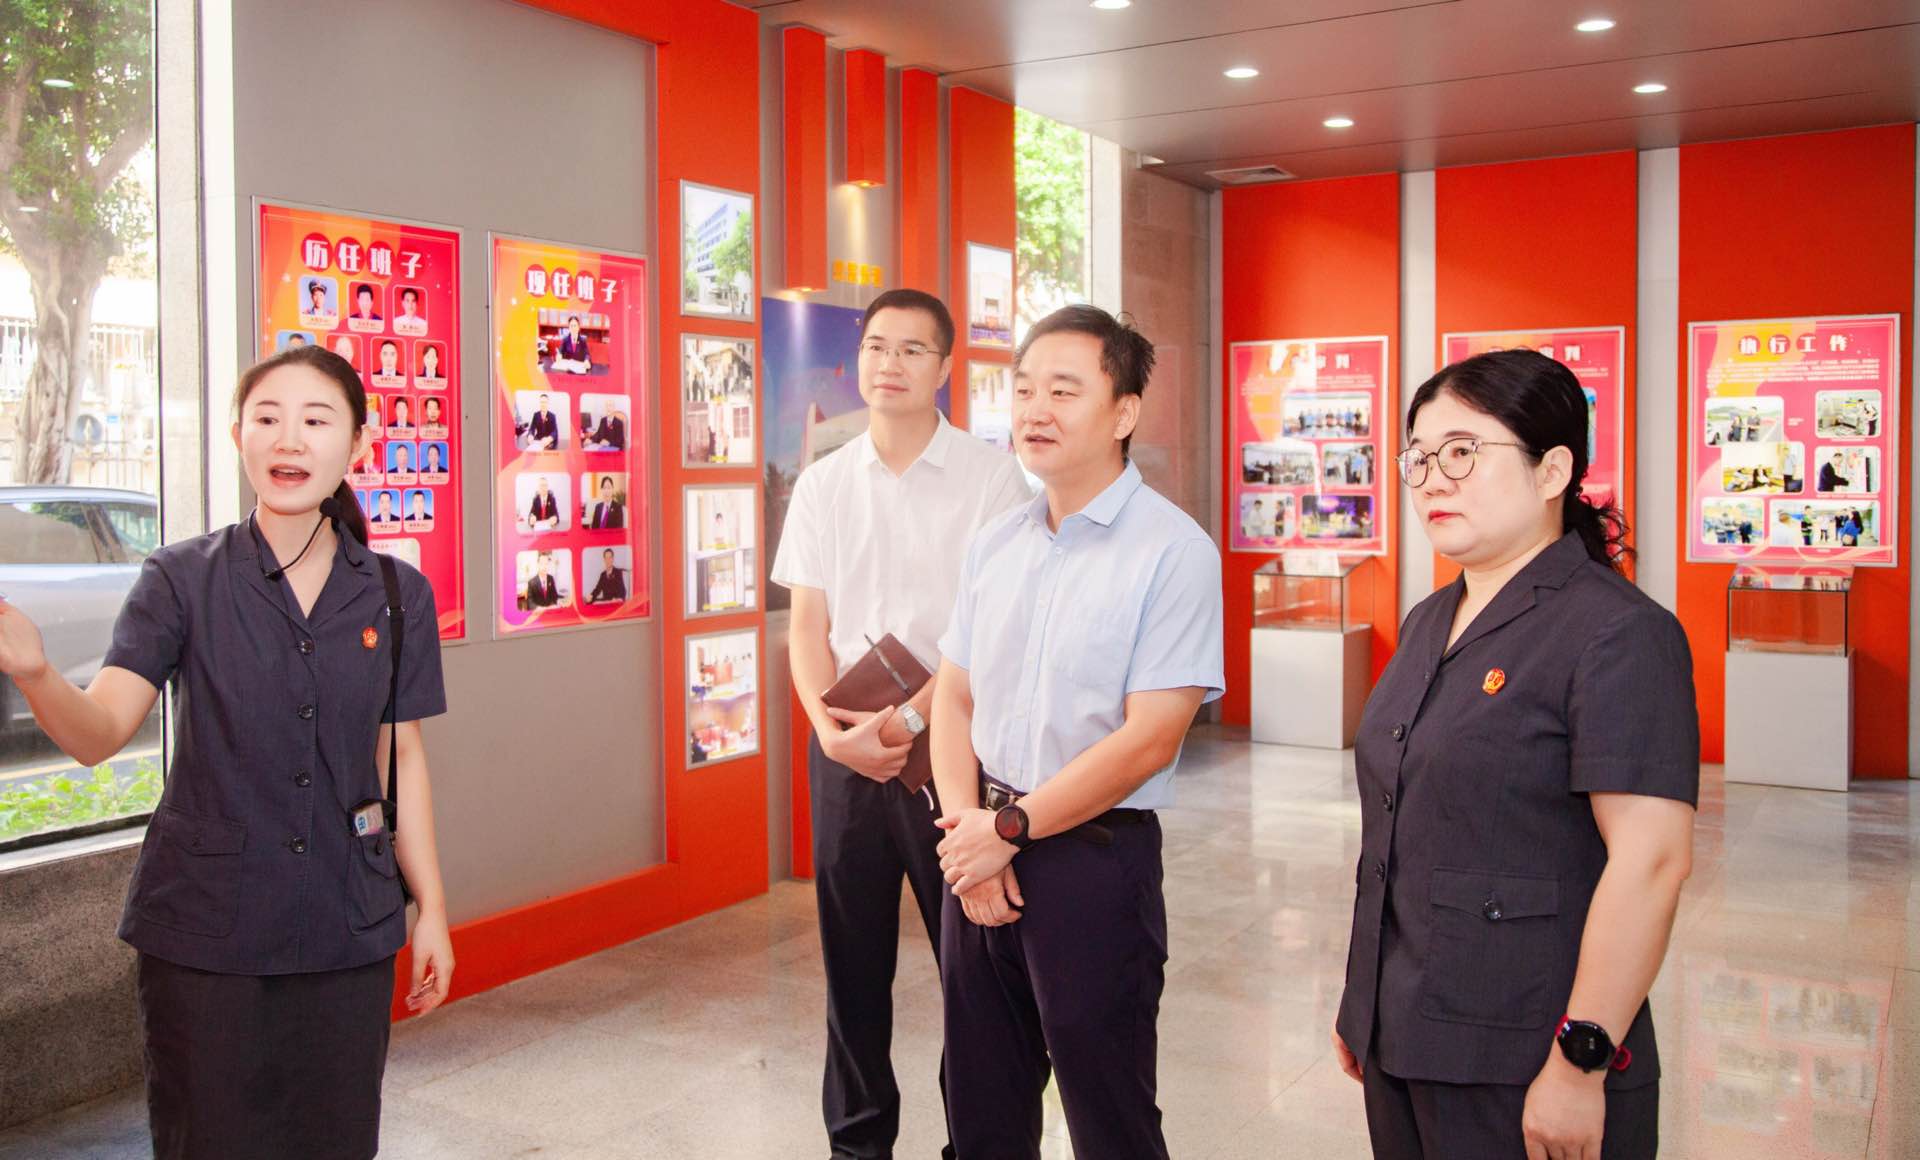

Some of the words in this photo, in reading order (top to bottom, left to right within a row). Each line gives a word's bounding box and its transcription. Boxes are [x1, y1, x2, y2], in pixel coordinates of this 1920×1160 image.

[304, 239, 422, 279] 历任班子
[527, 269, 618, 304] 现任班子
[1740, 334, 1848, 354] 执行工作
